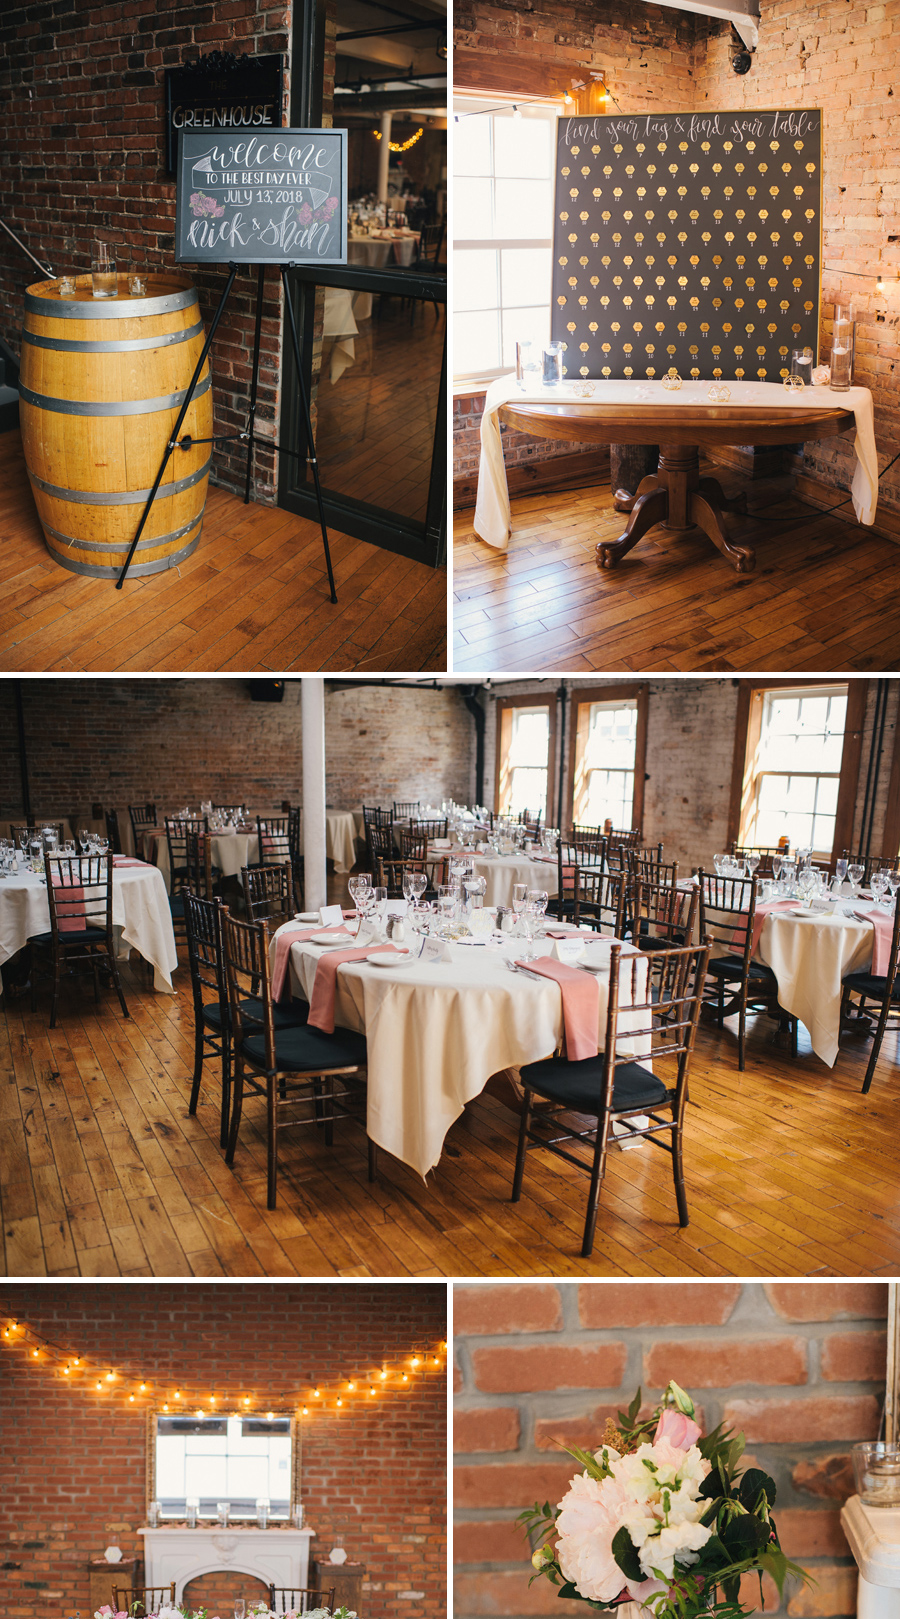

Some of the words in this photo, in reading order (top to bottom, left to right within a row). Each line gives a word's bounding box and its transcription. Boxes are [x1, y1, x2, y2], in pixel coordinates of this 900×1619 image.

[209, 81, 227, 90] THE
[559, 117, 601, 146] find
[606, 119, 639, 145] your
[635, 115, 672, 142] tag
[673, 117, 685, 134] &
[687, 114, 726, 143] find
[730, 117, 766, 143] your
[760, 111, 820, 139] table
[184, 137, 340, 170] welcome
[206, 172, 219, 185] TO
[221, 172, 239, 185] THE
[241, 171, 265, 185] BEST
[266, 172, 286, 185] DAY
[286, 172, 312, 185] EVER
[224, 189, 252, 207] JULY
[275, 190, 303, 204] 2018
[187, 212, 255, 249] nick
[251, 217, 261, 231] &
[257, 205, 335, 257] shan
